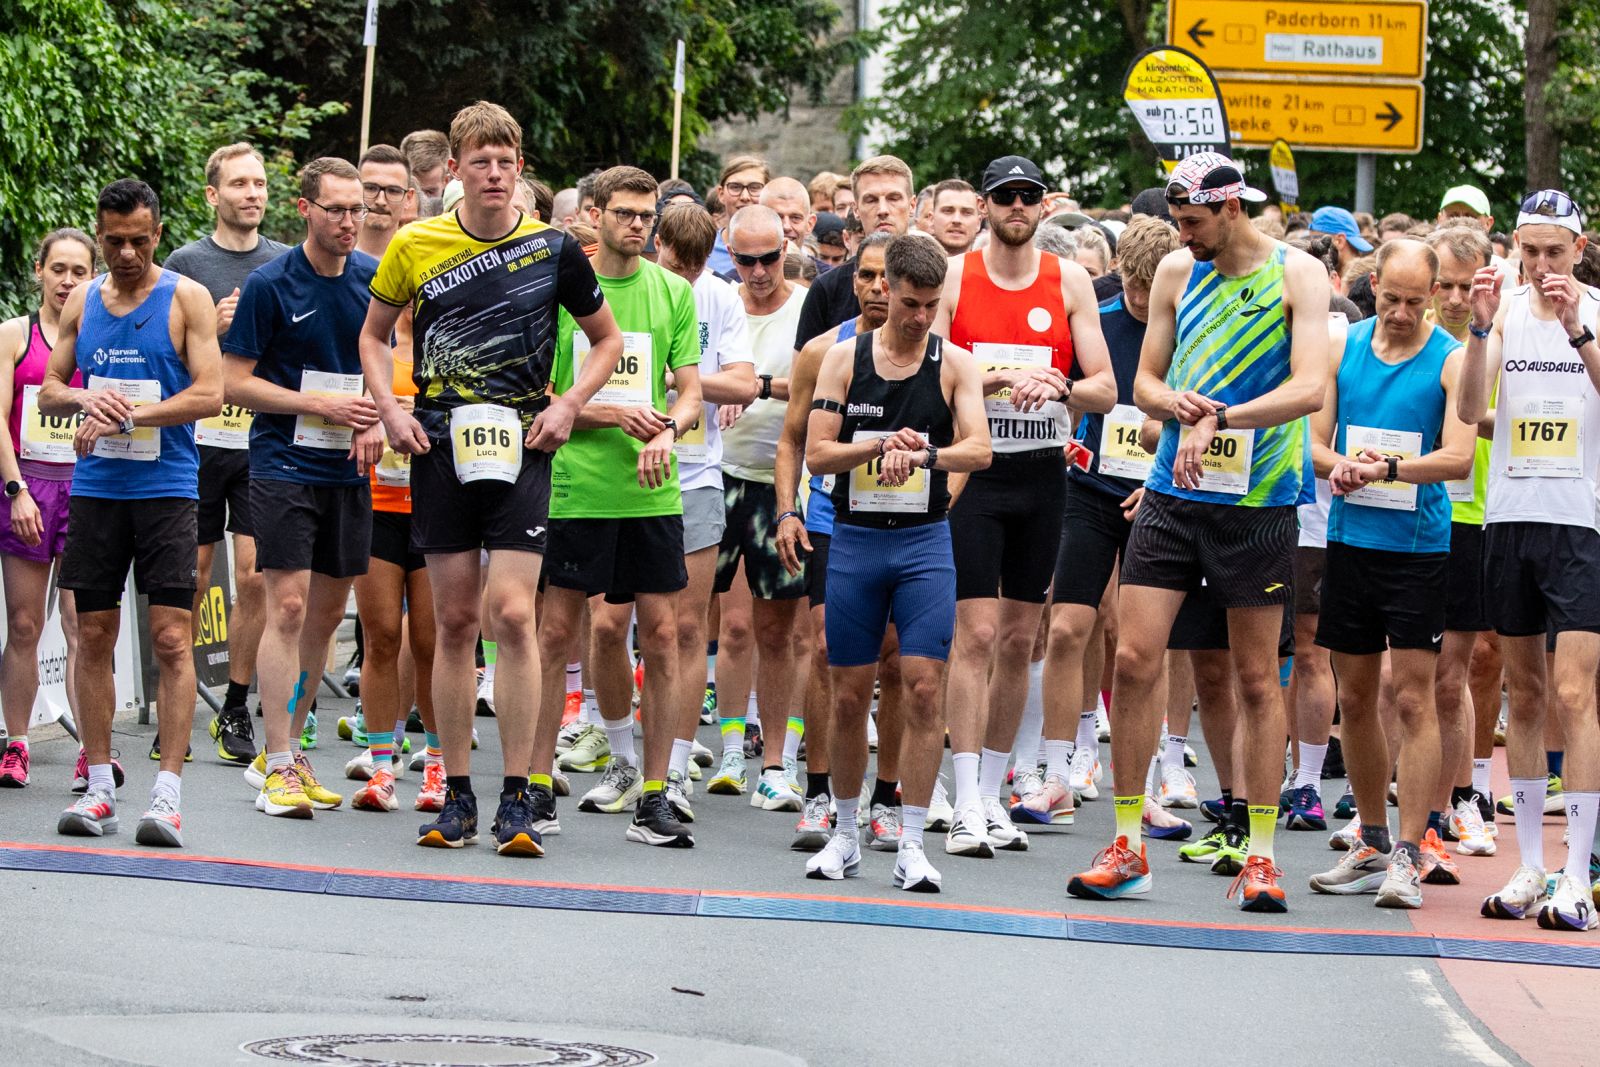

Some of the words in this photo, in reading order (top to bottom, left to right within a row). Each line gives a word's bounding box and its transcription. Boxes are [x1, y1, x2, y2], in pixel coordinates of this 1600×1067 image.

[1265, 10, 1360, 28] Paderborn
[1368, 13, 1383, 30] 11
[1387, 18, 1407, 30] km
[1303, 40, 1377, 60] Rathaus
[1137, 76, 1203, 84] SALZKOTTEN
[1137, 86, 1204, 94] MARATHON
[1224, 94, 1272, 110] witte
[1283, 95, 1301, 110] 21
[1304, 100, 1325, 111] km
[1146, 106, 1161, 117] sub
[1163, 108, 1215, 136] 0:50
[1289, 117, 1299, 133] 9
[1303, 122, 1324, 134] km
[419, 273, 430, 282] 13.
[430, 248, 474, 275] KLINGENTHAL
[423, 249, 503, 301] SALZKOTTEN
[502, 237, 548, 263] MARATHON
[507, 261, 519, 273] 06.
[519, 256, 534, 270] JUNI
[533, 248, 552, 264] 2021
[1206, 303, 1241, 335] ENDSPURT
[109, 348, 139, 356] Narwan
[109, 356, 146, 364] Electronic
[1527, 361, 1585, 374] AUSDAUER
[847, 403, 884, 417] Reiling
[223, 419, 242, 428] Marc
[1518, 421, 1569, 442] 1767
[50, 431, 73, 441] Stella
[462, 426, 510, 448] 1616
[1116, 427, 1142, 447] 14
[476, 449, 498, 457] Luca
[1126, 449, 1146, 458] Marc
[1203, 437, 1237, 458] 90
[1114, 798, 1139, 806] cep
